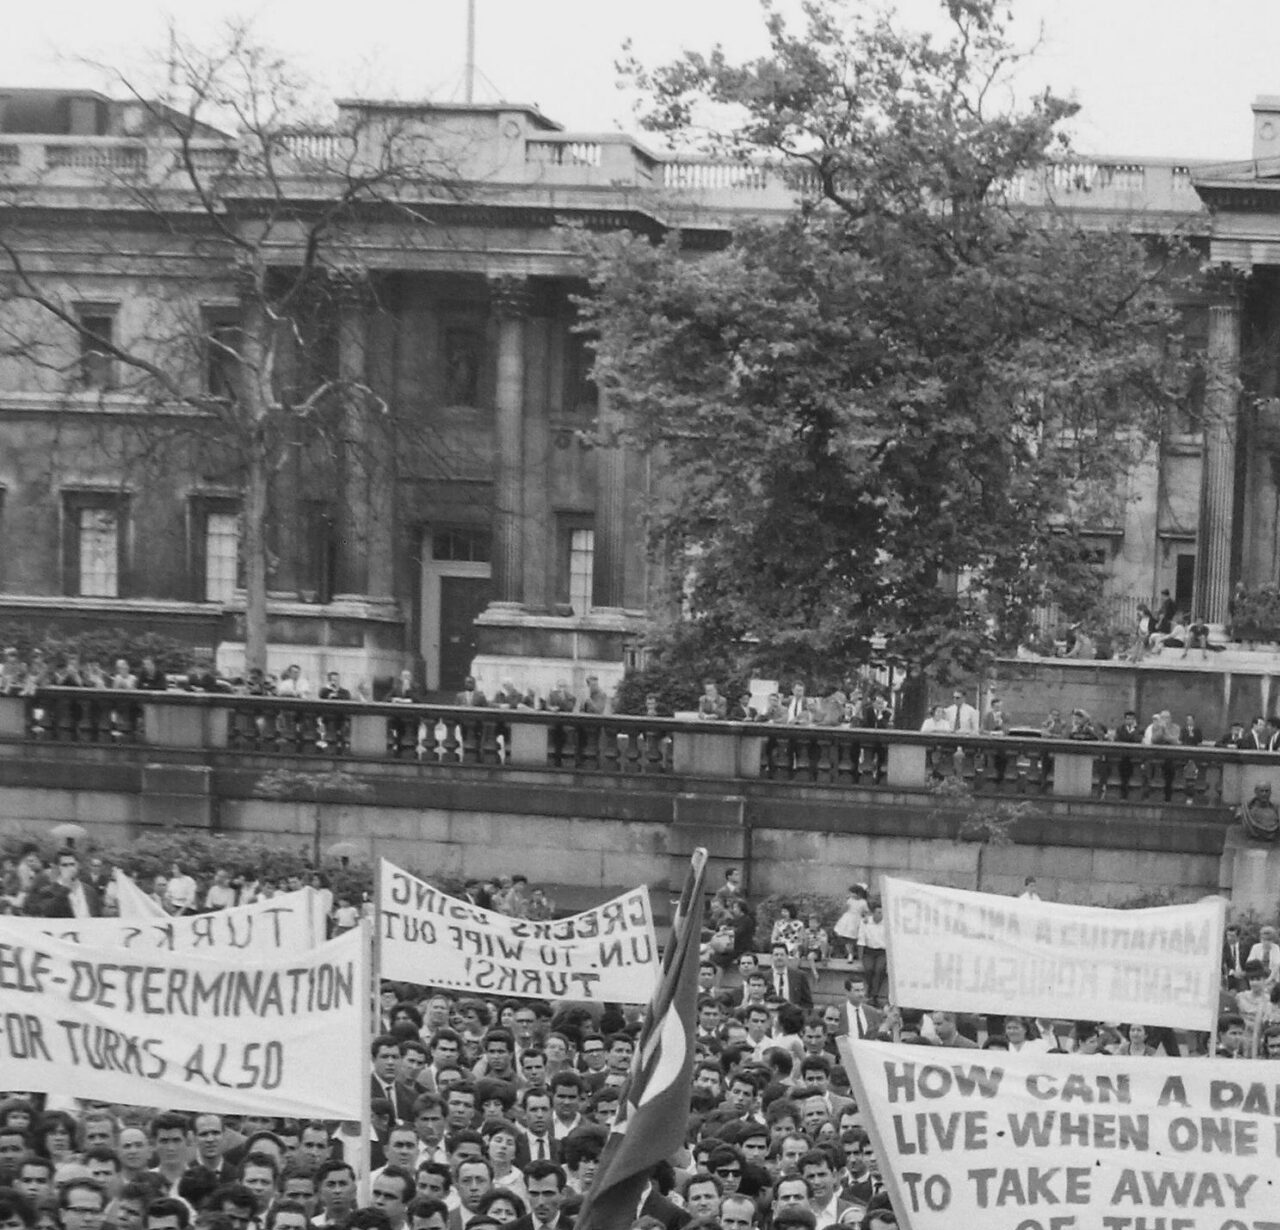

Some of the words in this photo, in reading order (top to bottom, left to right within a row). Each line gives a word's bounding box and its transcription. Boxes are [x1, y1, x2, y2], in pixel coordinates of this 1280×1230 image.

[0, 1012, 53, 1061] OR
[184, 1040, 283, 1090] ALSO
[884, 1061, 1005, 1103] HOW
[1025, 1072, 1132, 1104] CAN
[1157, 1075, 1192, 1108] A
[892, 1110, 988, 1155] LIVE
[1007, 1110, 1150, 1151] WHEN
[1167, 1116, 1259, 1157] ONE
[901, 1172, 951, 1213] TO
[967, 1166, 1092, 1209] TAKE
[1109, 1168, 1259, 1209] AWAY
